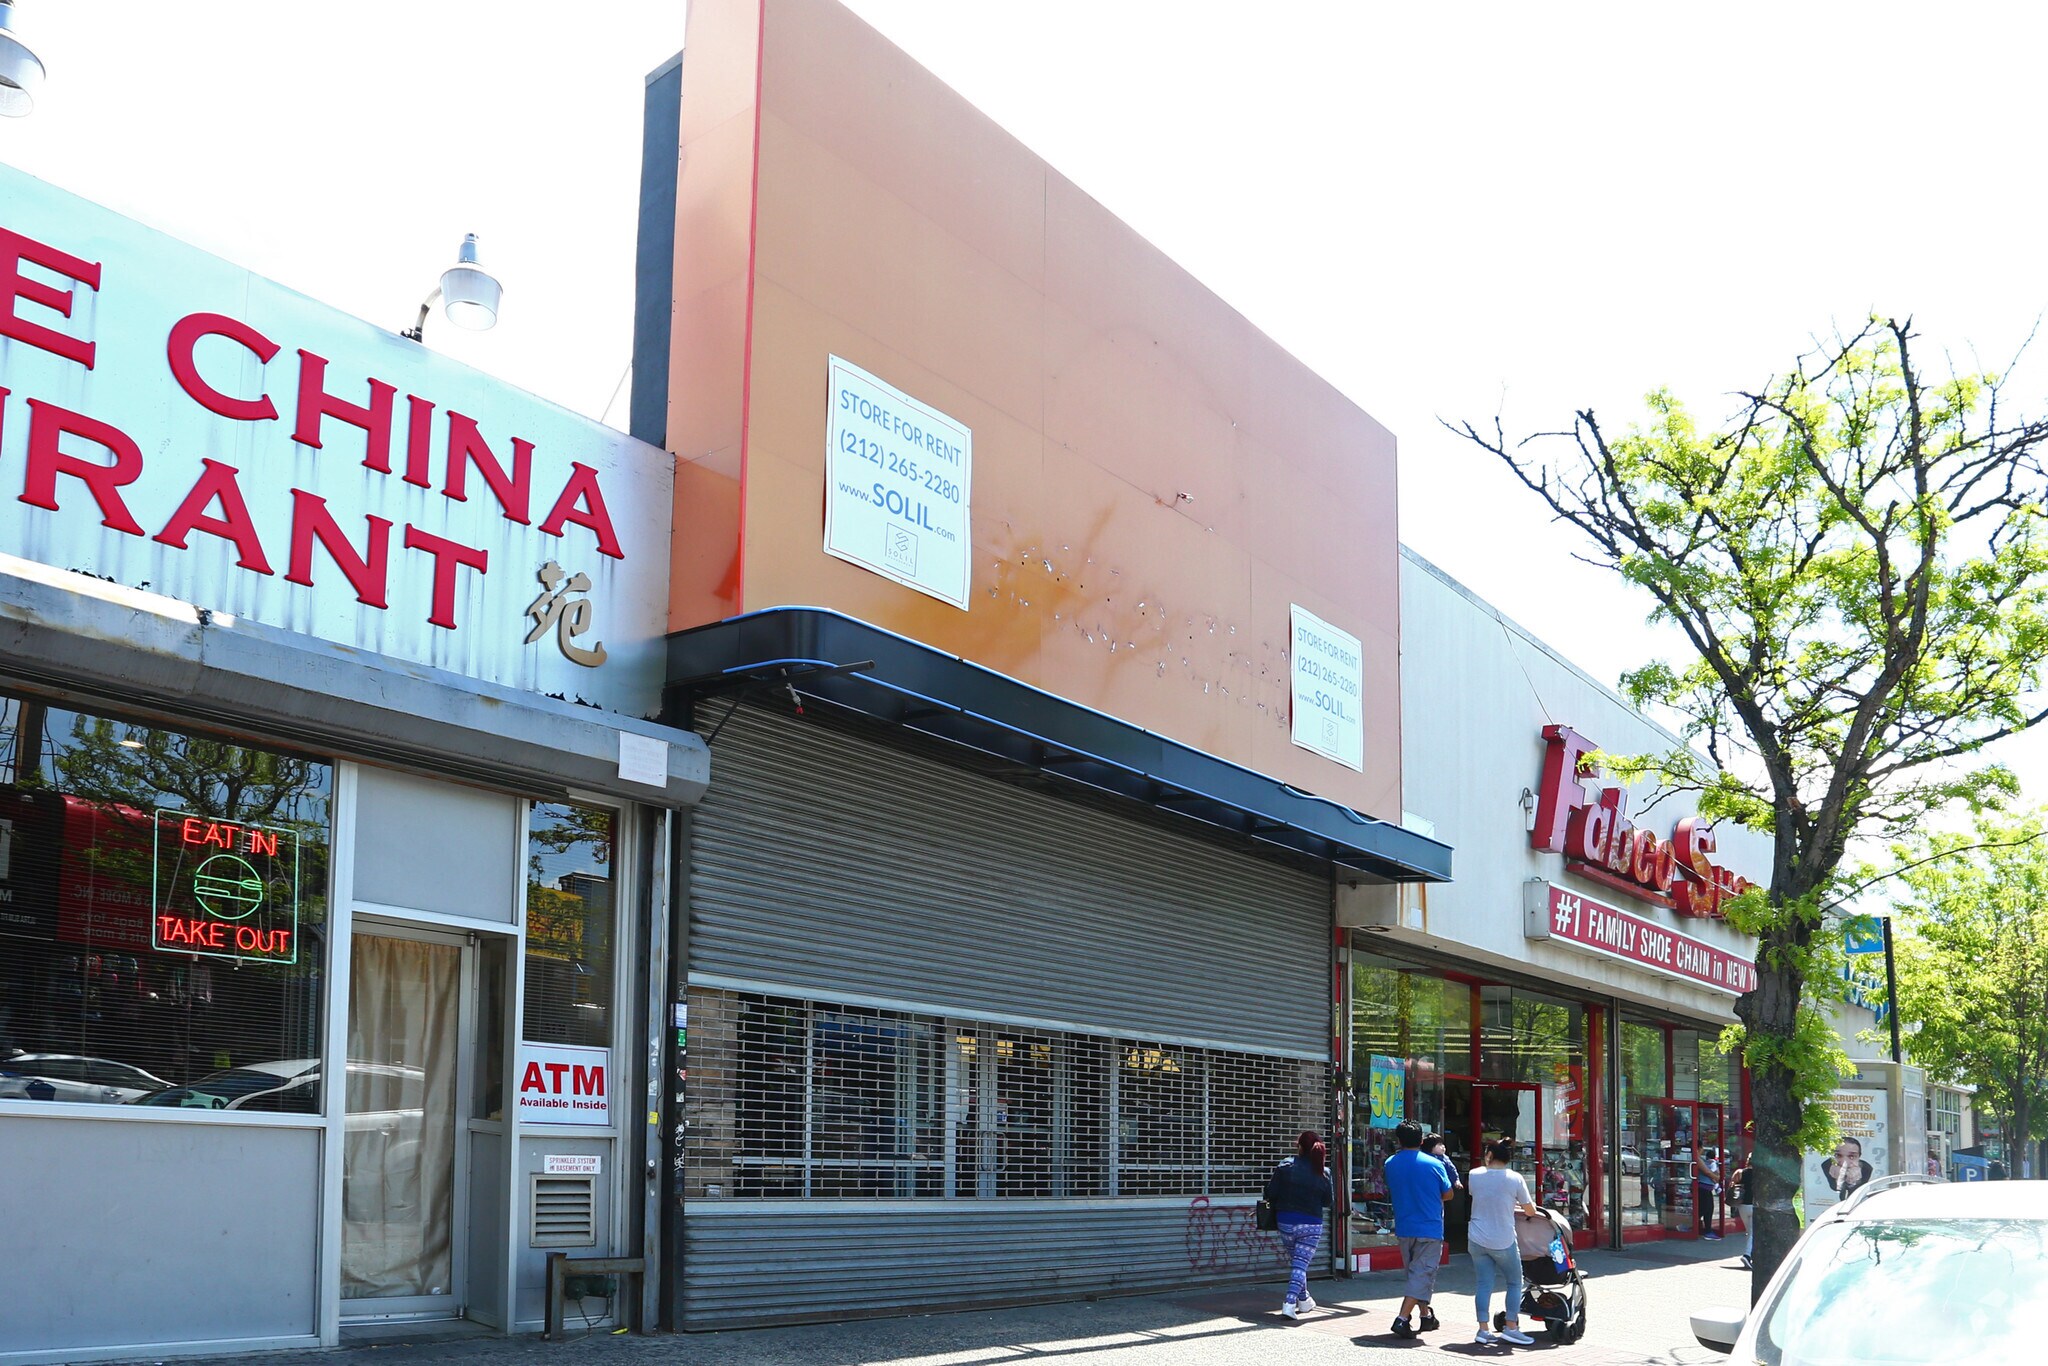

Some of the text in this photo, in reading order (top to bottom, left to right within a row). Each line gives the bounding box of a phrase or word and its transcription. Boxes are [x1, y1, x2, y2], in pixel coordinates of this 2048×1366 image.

[166, 311, 624, 560] CHINA
[840, 389, 962, 467] STORE FOR RENT
[840, 428, 960, 504] (212) 265-2280
[0, 386, 488, 631] RANT
[525, 560, 607, 667] 苑
[1297, 627, 1358, 671] STORE FOR RENT
[1298, 655, 1358, 698] (212) 265-2280
[183, 818, 278, 857] EAT IN
[1532, 724, 1677, 892] Fabco
[158, 915, 291, 953] TAKE OUT
[1555, 893, 1582, 937] #1
[1588, 908, 1637, 953] FAMILY
[1640, 927, 1672, 965] SHOE
[1676, 941, 1710, 977] CHAIN
[1713, 955, 1723, 981] in
[1726, 959, 1747, 989] NEW
[520, 1061, 605, 1096] ATM
[520, 1097, 607, 1110] Available Inside
[1966, 1168, 1978, 1182] P
